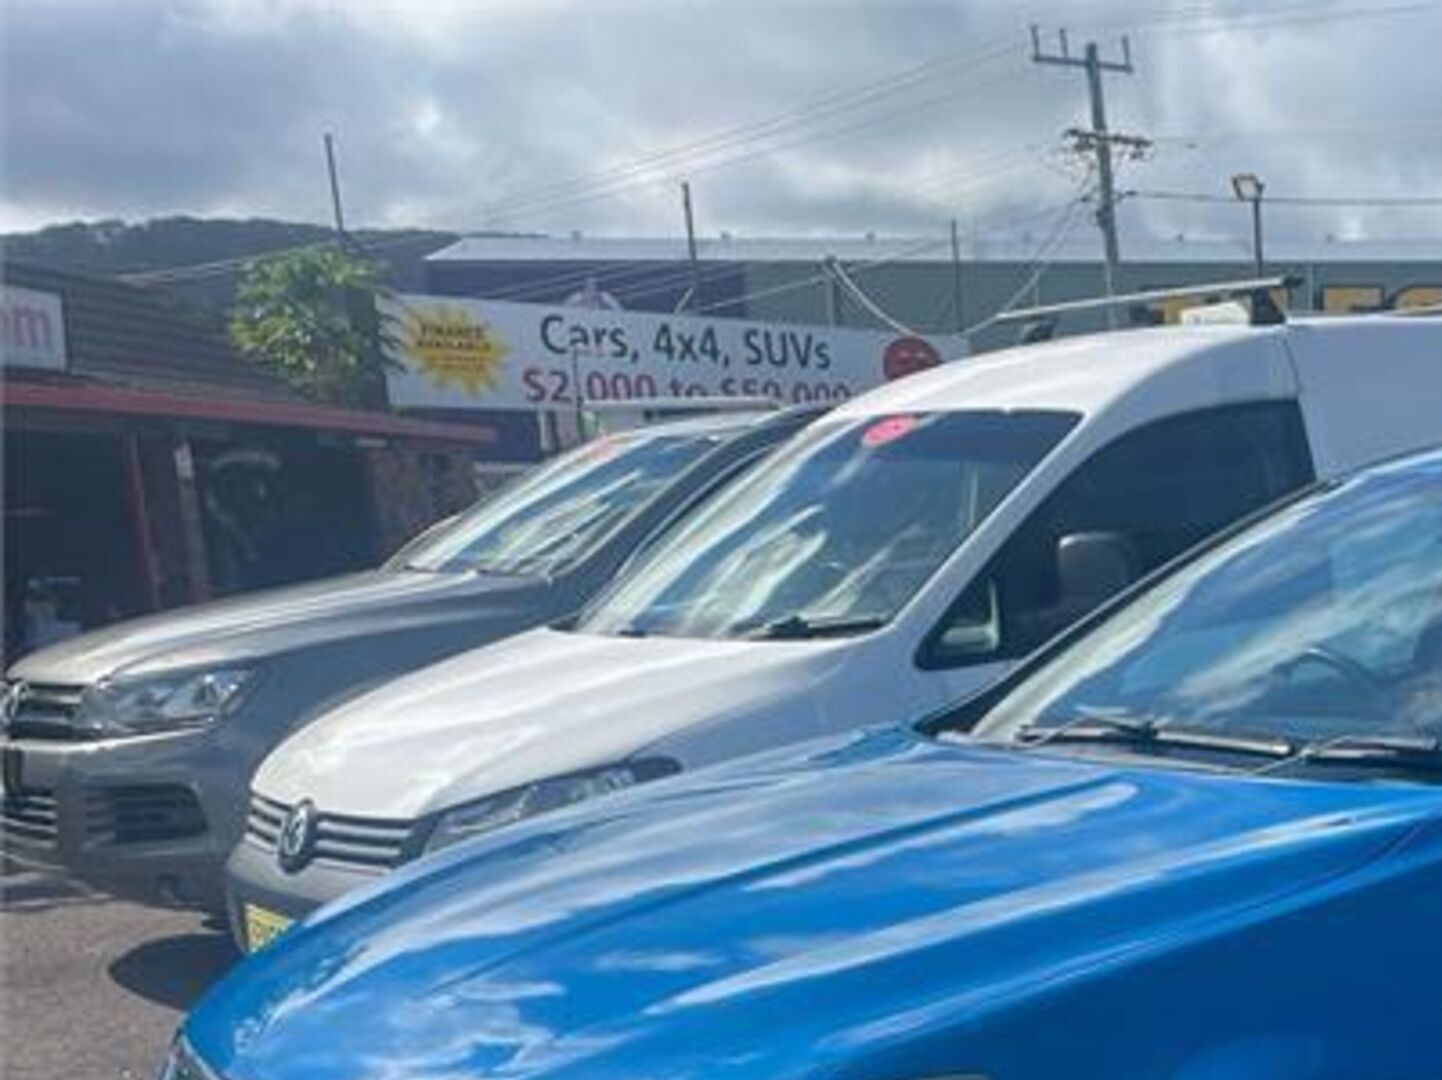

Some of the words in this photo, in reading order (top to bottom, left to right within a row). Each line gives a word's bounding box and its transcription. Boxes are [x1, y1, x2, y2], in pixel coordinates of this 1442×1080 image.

[540, 314, 639, 363] Cars,
[653, 323, 730, 367] 4x4,
[744, 328, 832, 369] SUVs
